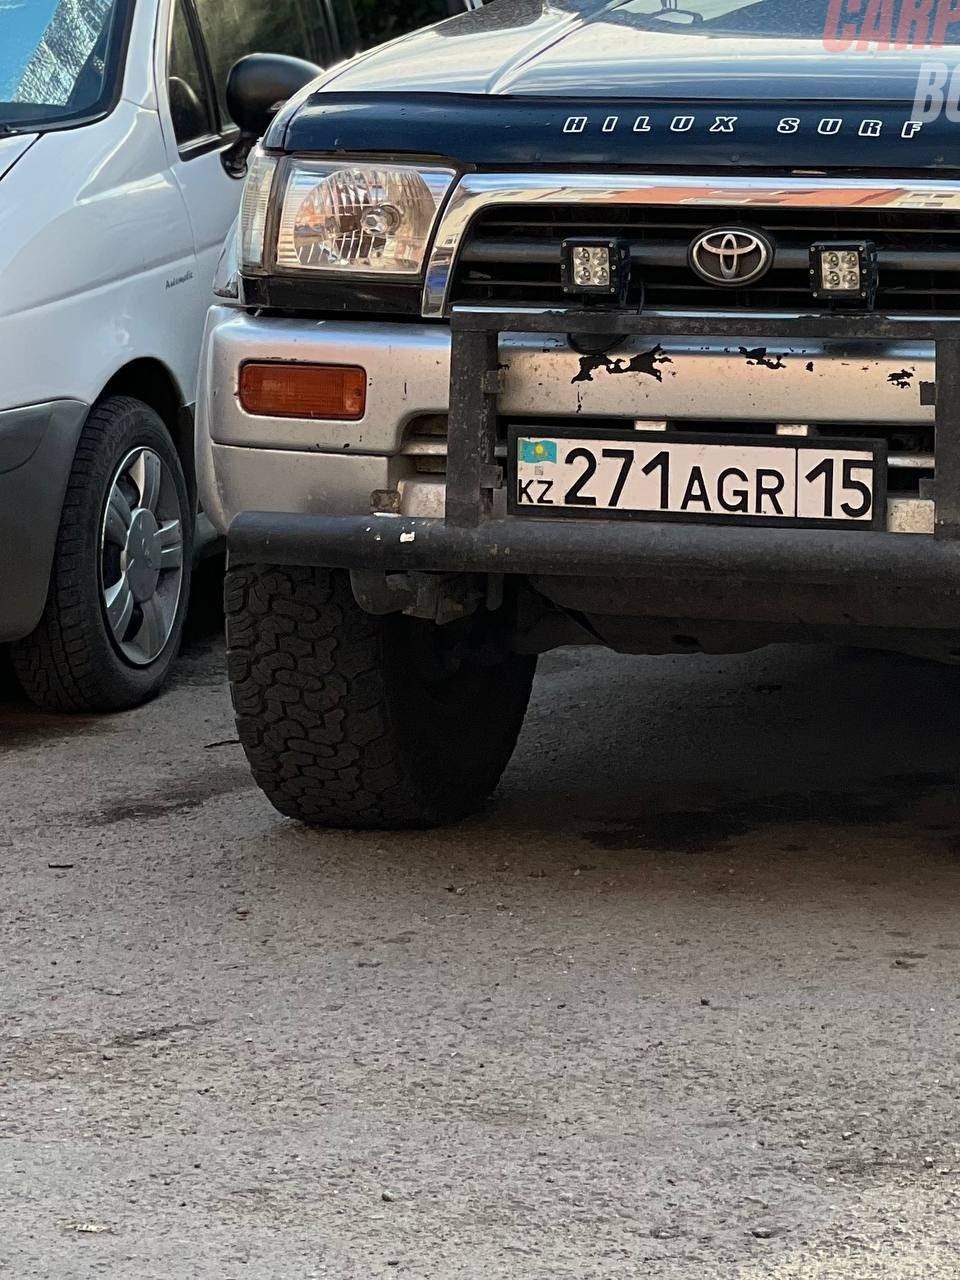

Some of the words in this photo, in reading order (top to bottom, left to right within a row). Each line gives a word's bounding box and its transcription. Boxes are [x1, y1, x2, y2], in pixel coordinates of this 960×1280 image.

[563, 116, 738, 134] HILUX
[776, 117, 923, 138] SURF
[518, 479, 554, 504] KZ
